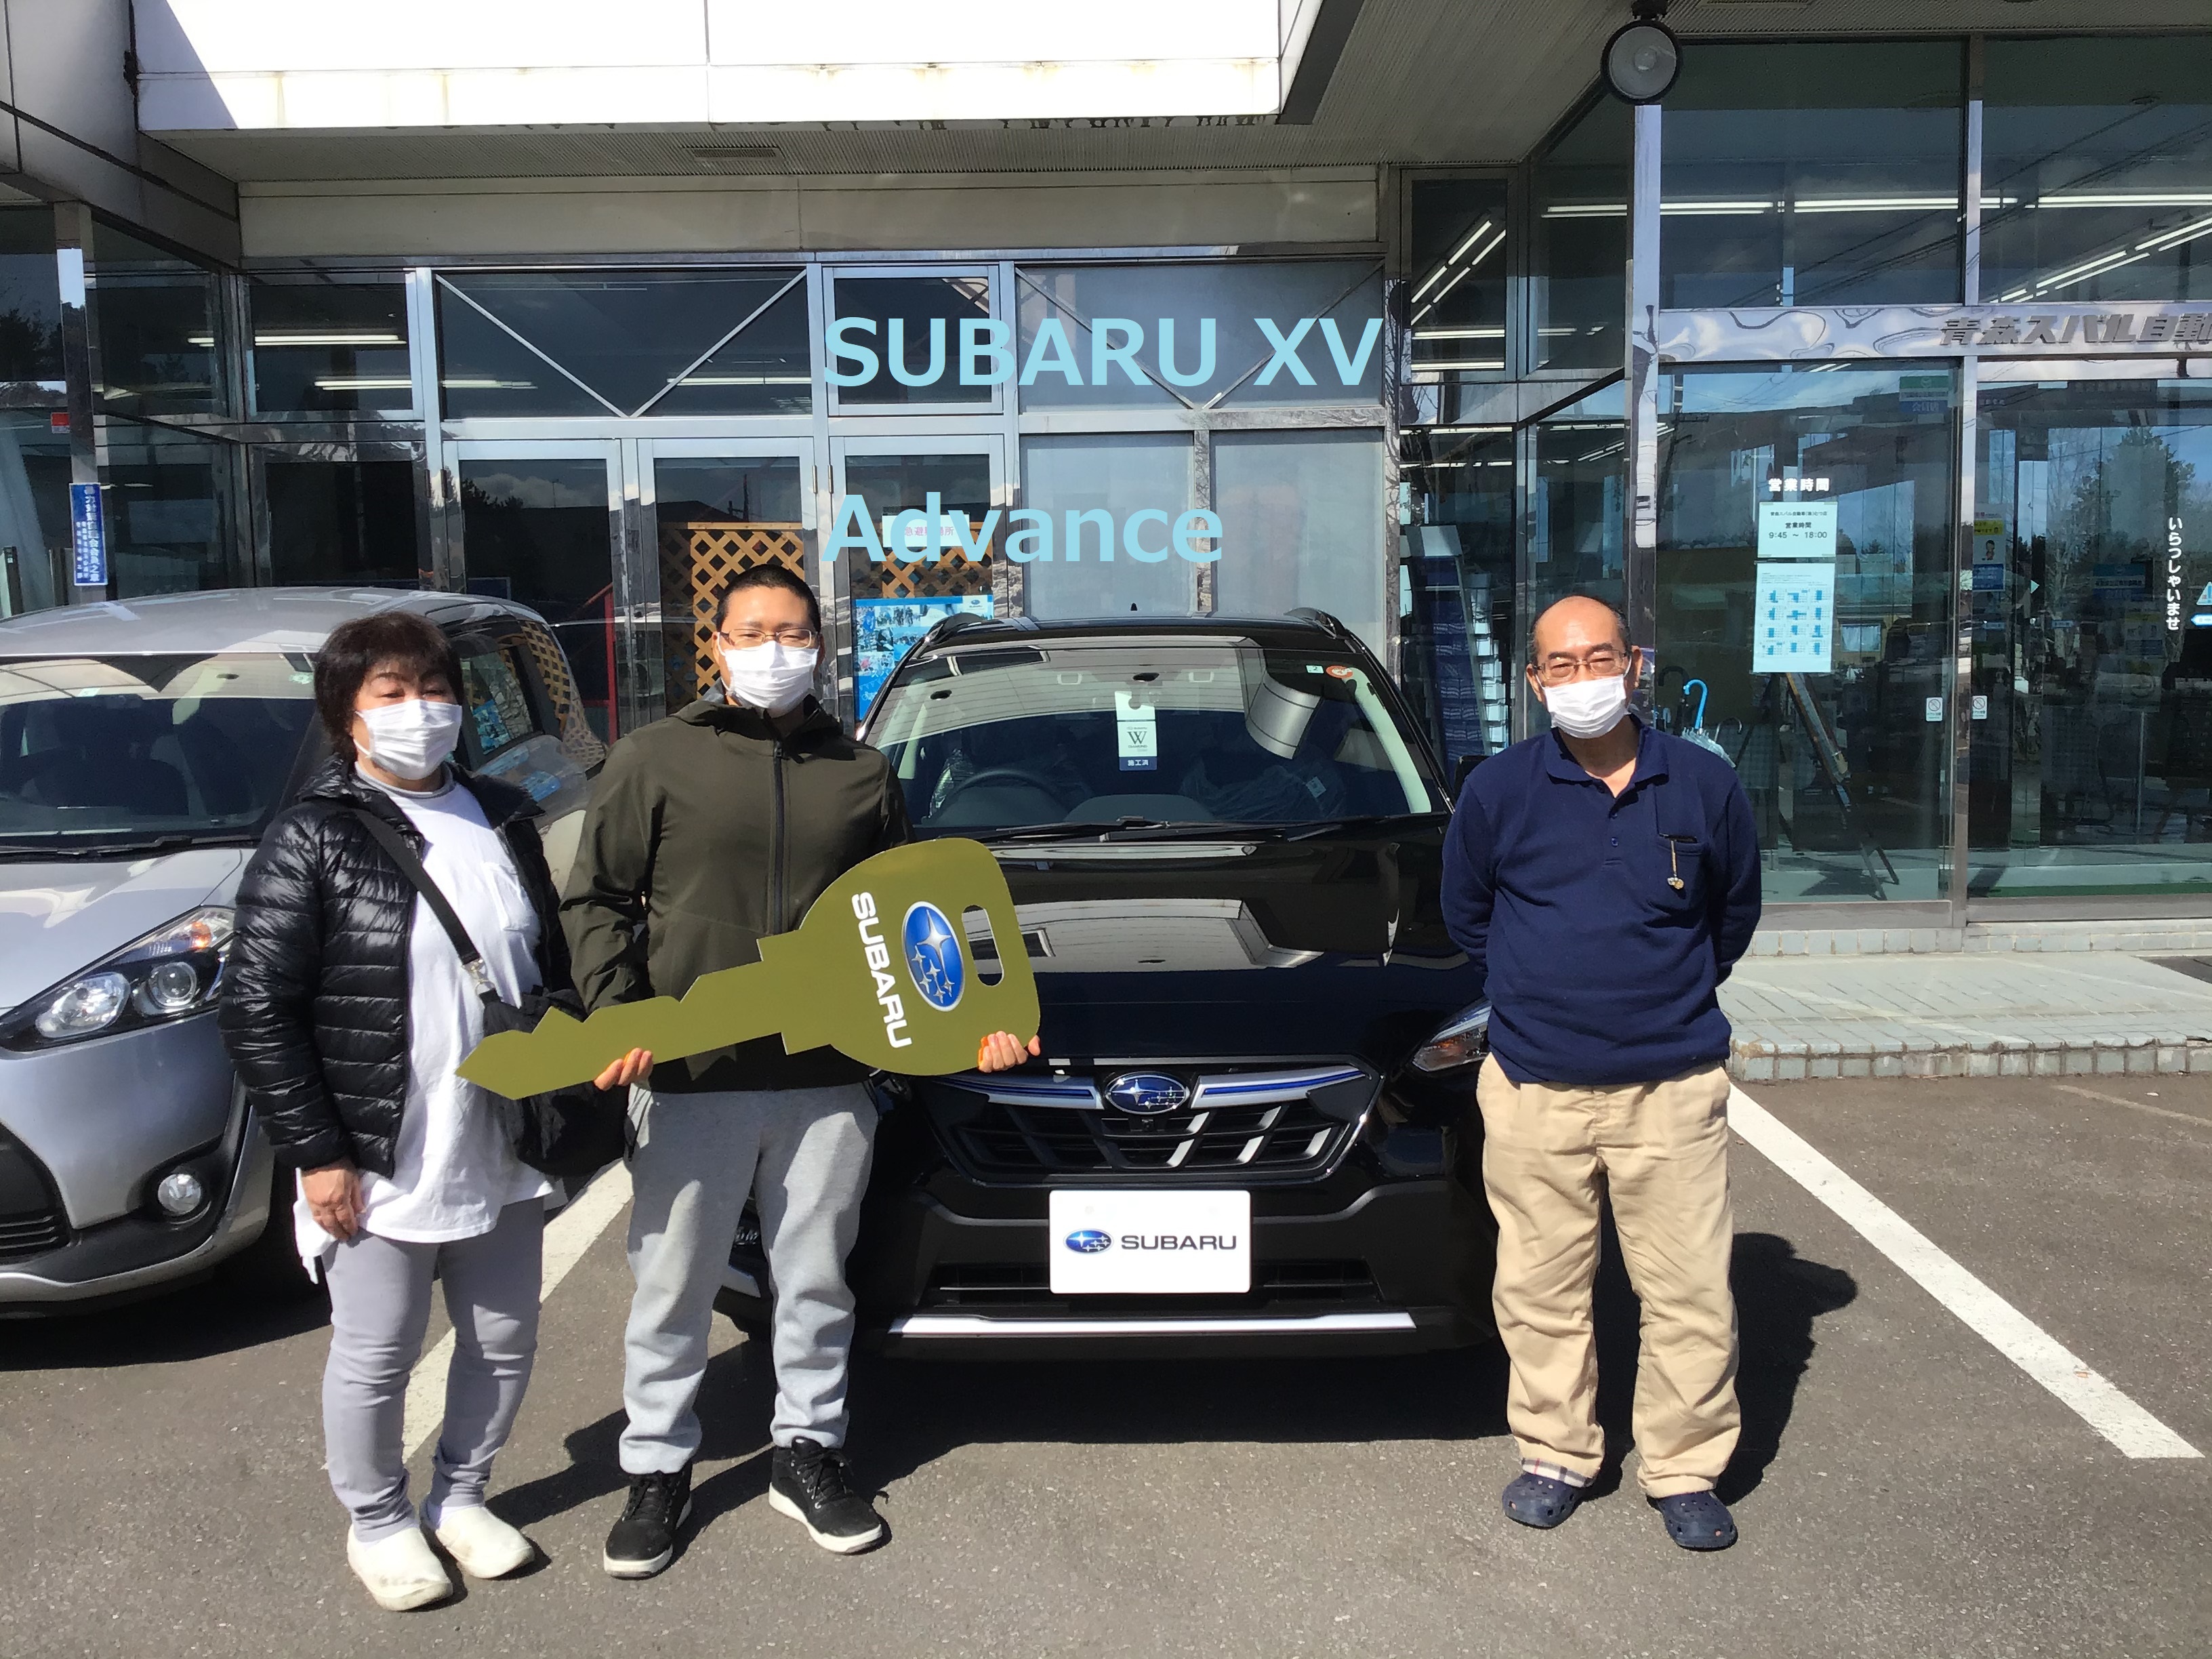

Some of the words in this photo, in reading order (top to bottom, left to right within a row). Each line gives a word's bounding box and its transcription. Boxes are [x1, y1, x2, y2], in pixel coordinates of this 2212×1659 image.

[1768, 478, 1830, 492] 営業時間
[1127, 731, 1148, 744] W
[851, 891, 913, 1048] SUBARU
[1121, 1235, 1237, 1250] SUBARU
